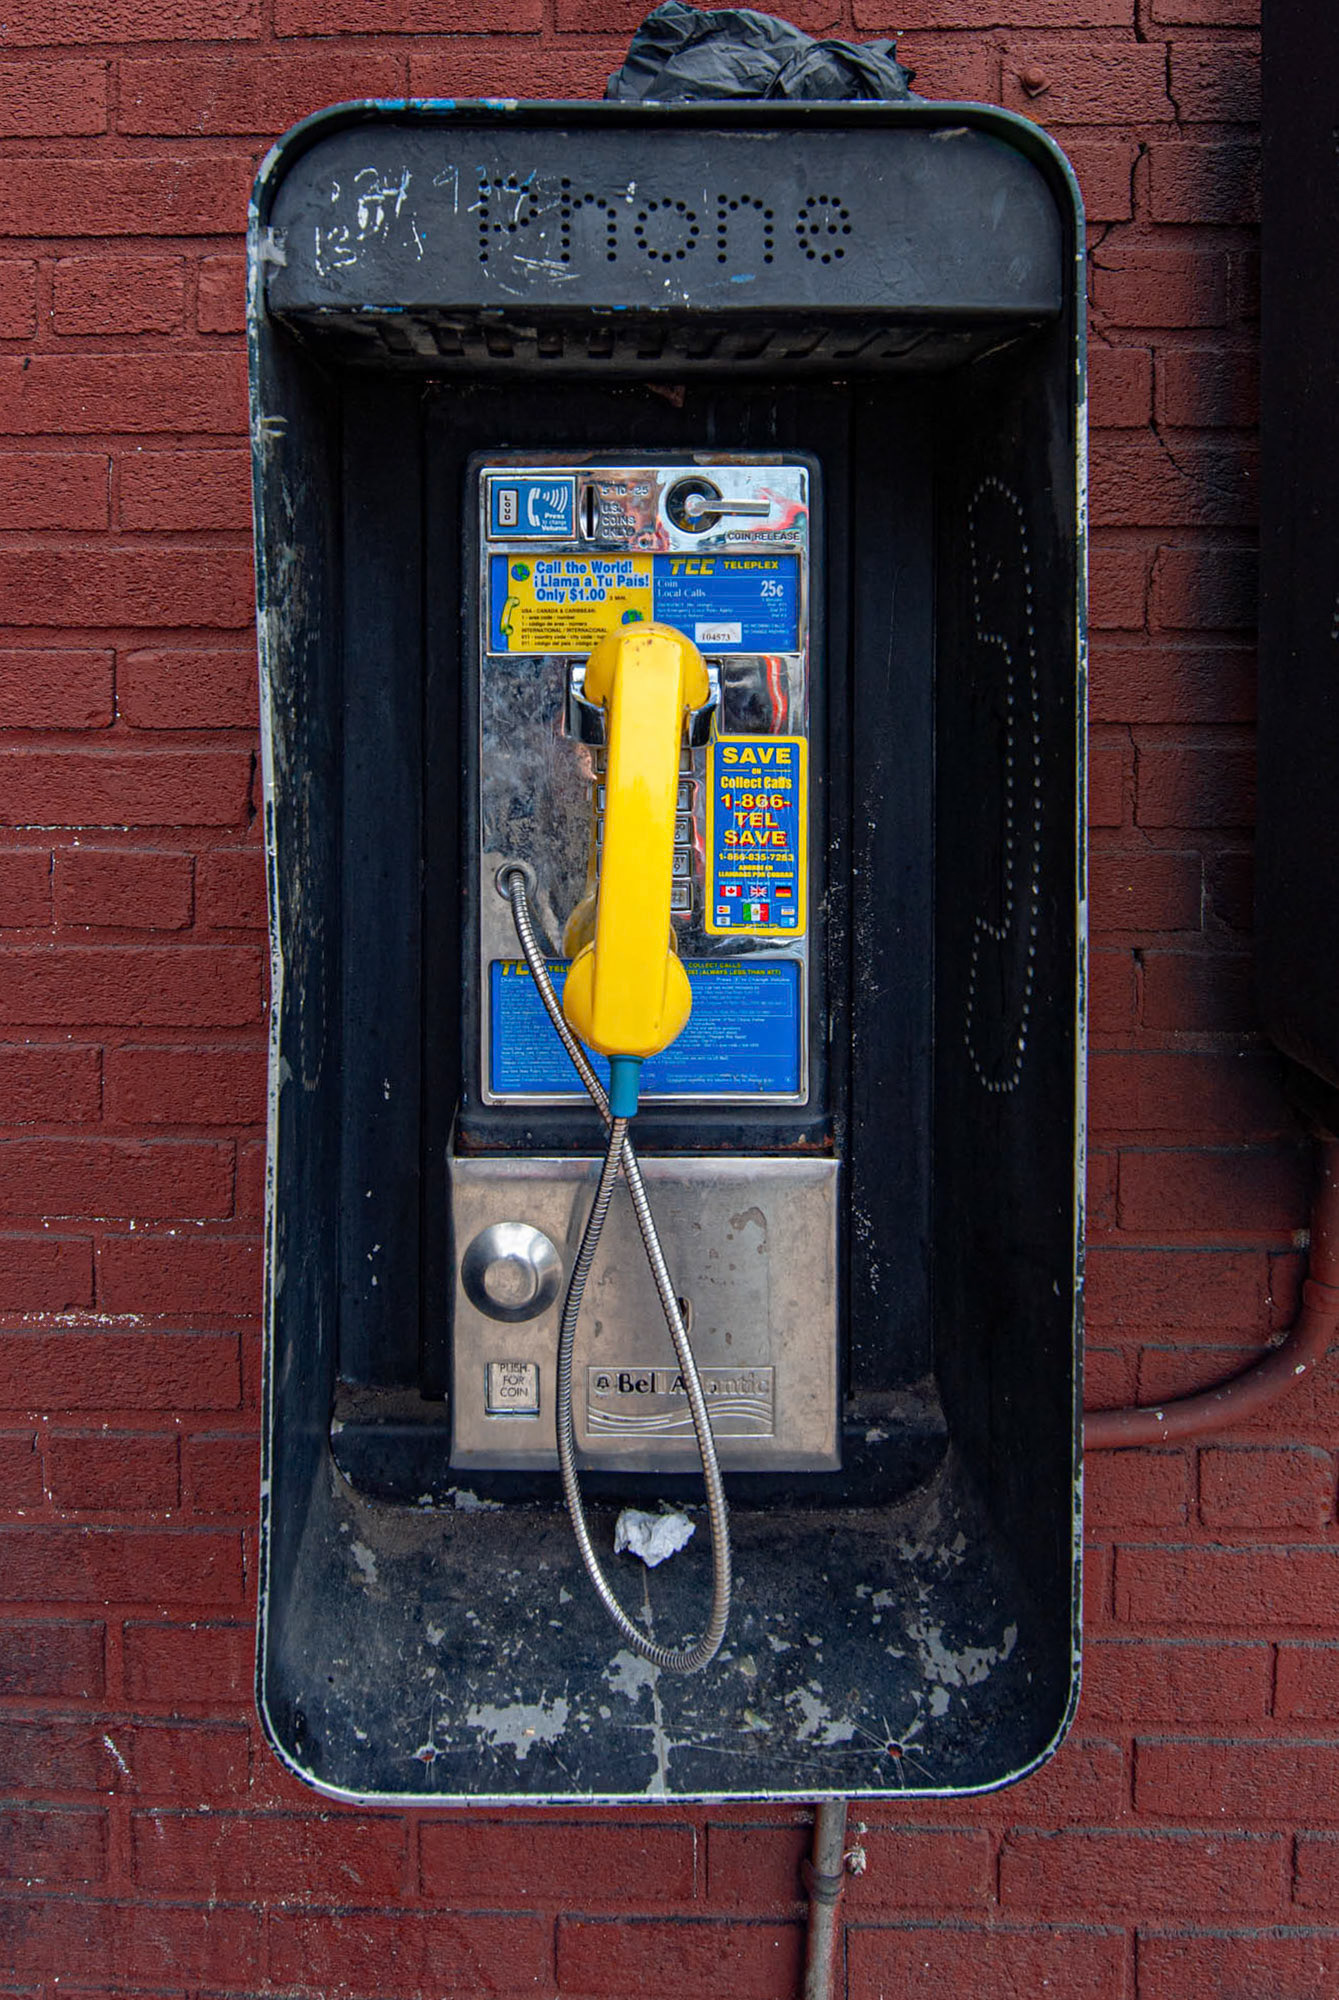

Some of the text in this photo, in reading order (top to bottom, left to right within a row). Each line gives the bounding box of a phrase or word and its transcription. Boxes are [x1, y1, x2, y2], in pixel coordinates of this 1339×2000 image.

[479, 178, 851, 263] Phone
[503, 493, 511, 521] LOUD
[600, 514, 636, 526] COINS
[727, 531, 800, 541] COIN RELEASE
[536, 560, 634, 574] Call the World!
[723, 560, 779, 570] TELEPLEX
[583, 576, 593, 587] a
[596, 574, 614, 588] Tu
[656, 579, 678, 588] Coin
[536, 588, 566, 604] Only
[569, 588, 606, 603] $1.00
[656, 588, 682, 598] Local
[684, 588, 707, 598] Calls
[722, 746, 792, 765] SAVE
[720, 776, 793, 790] Collect Calls
[720, 793, 793, 811] 1-866-
[733, 812, 780, 829] TEL
[723, 830, 788, 847] SAVE
[500, 1362, 528, 1373] PUSH
[503, 1374, 525, 1386] FOR
[617, 1372, 666, 1396] Bell
[500, 1387, 528, 1398] COIN
